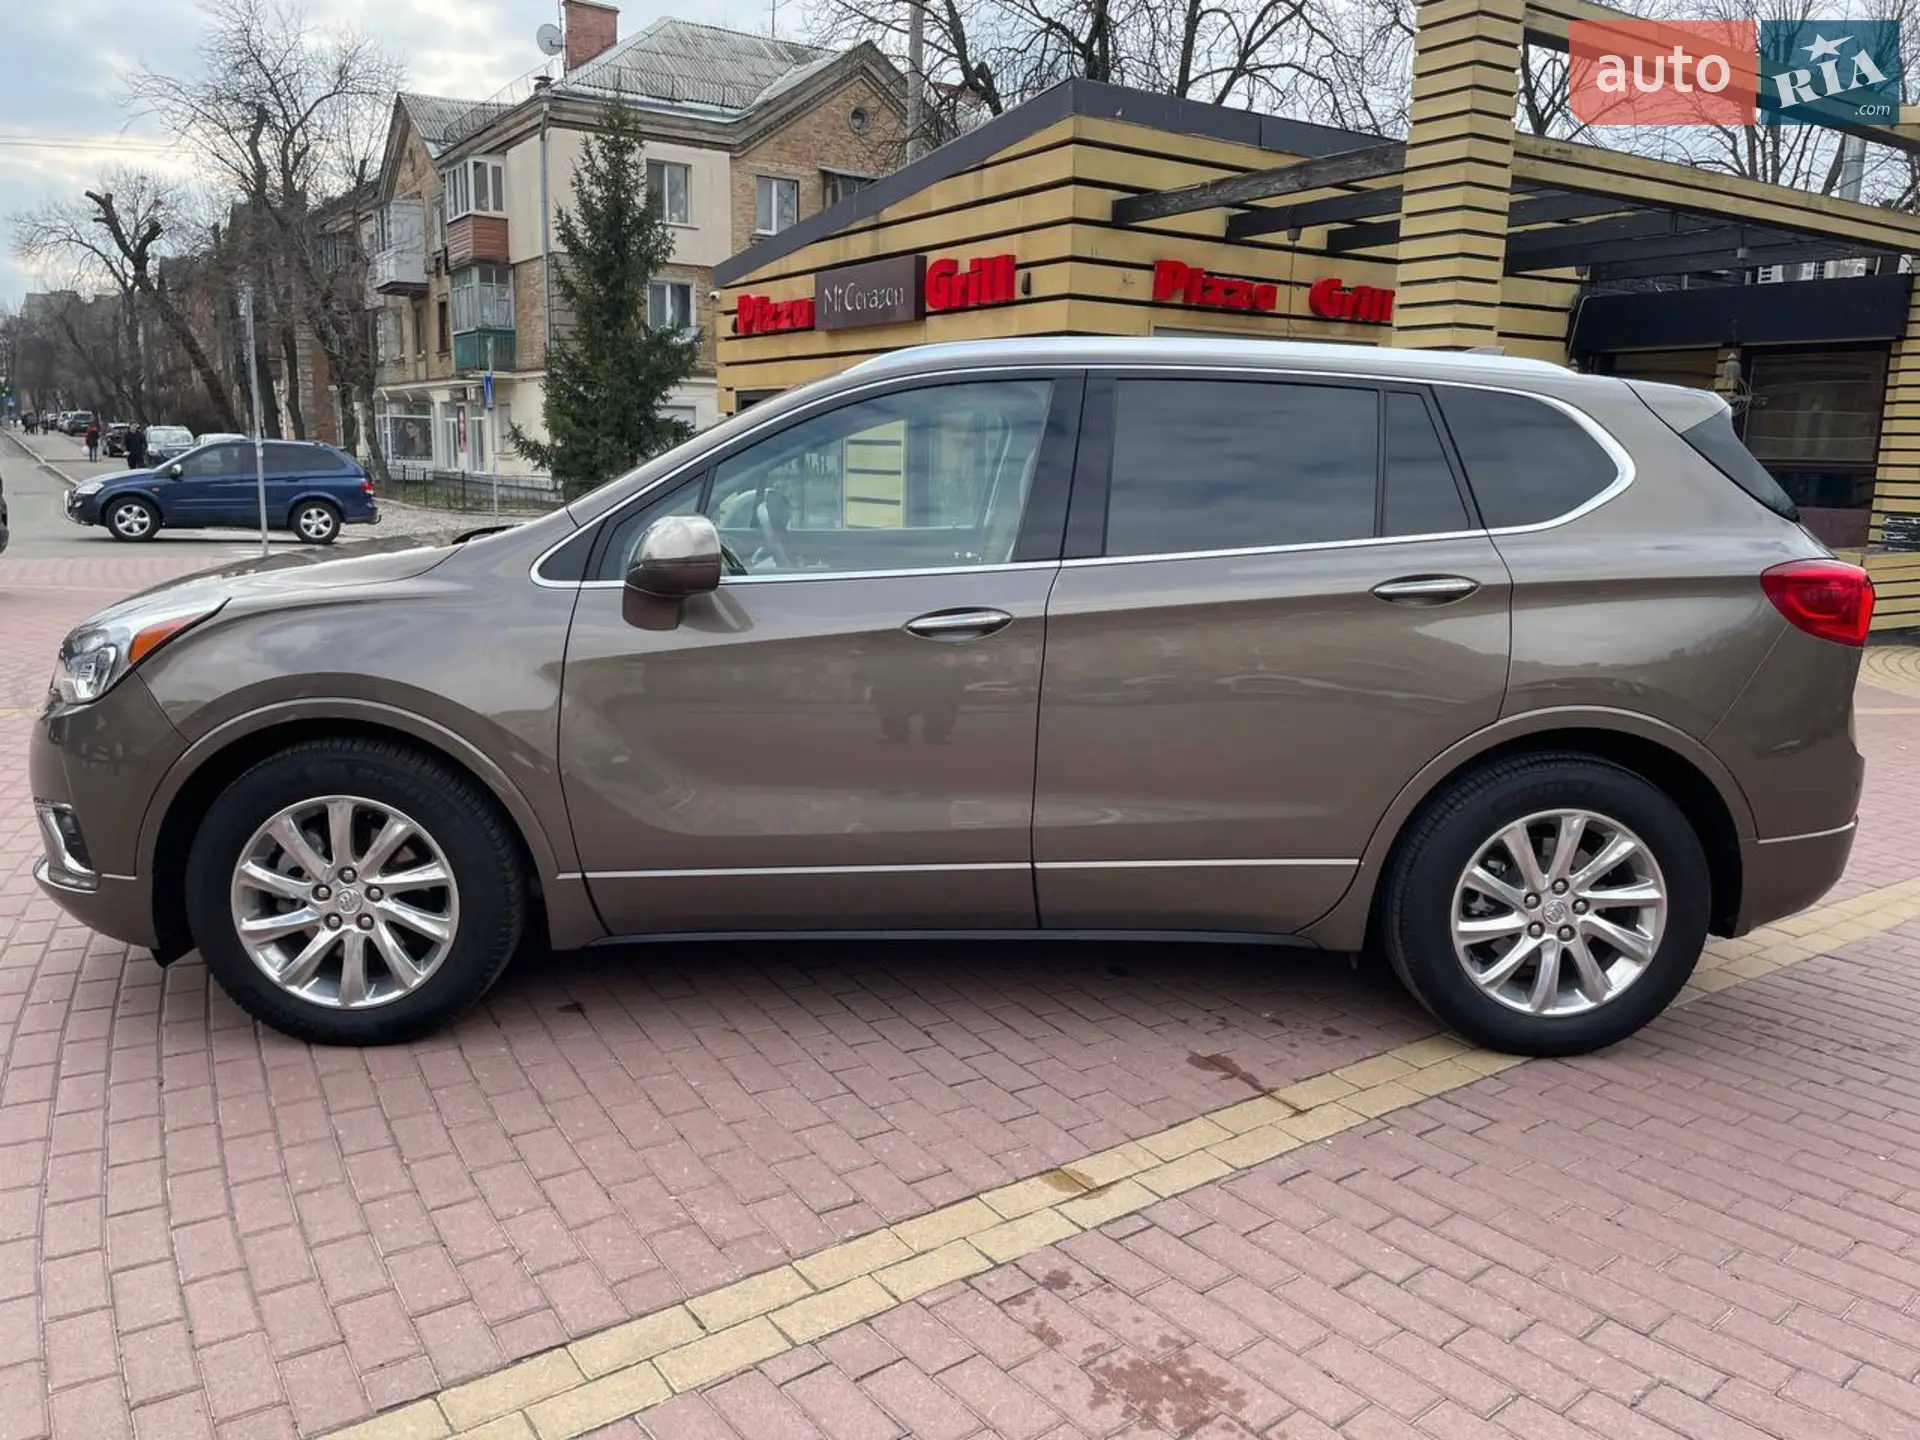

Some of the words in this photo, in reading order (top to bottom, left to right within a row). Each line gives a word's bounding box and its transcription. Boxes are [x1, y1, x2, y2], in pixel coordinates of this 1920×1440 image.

[925, 254, 1016, 310] Grill
[1152, 260, 1278, 312] Pizza
[1308, 278, 1396, 323] Grill
[737, 294, 816, 335] Pizza
